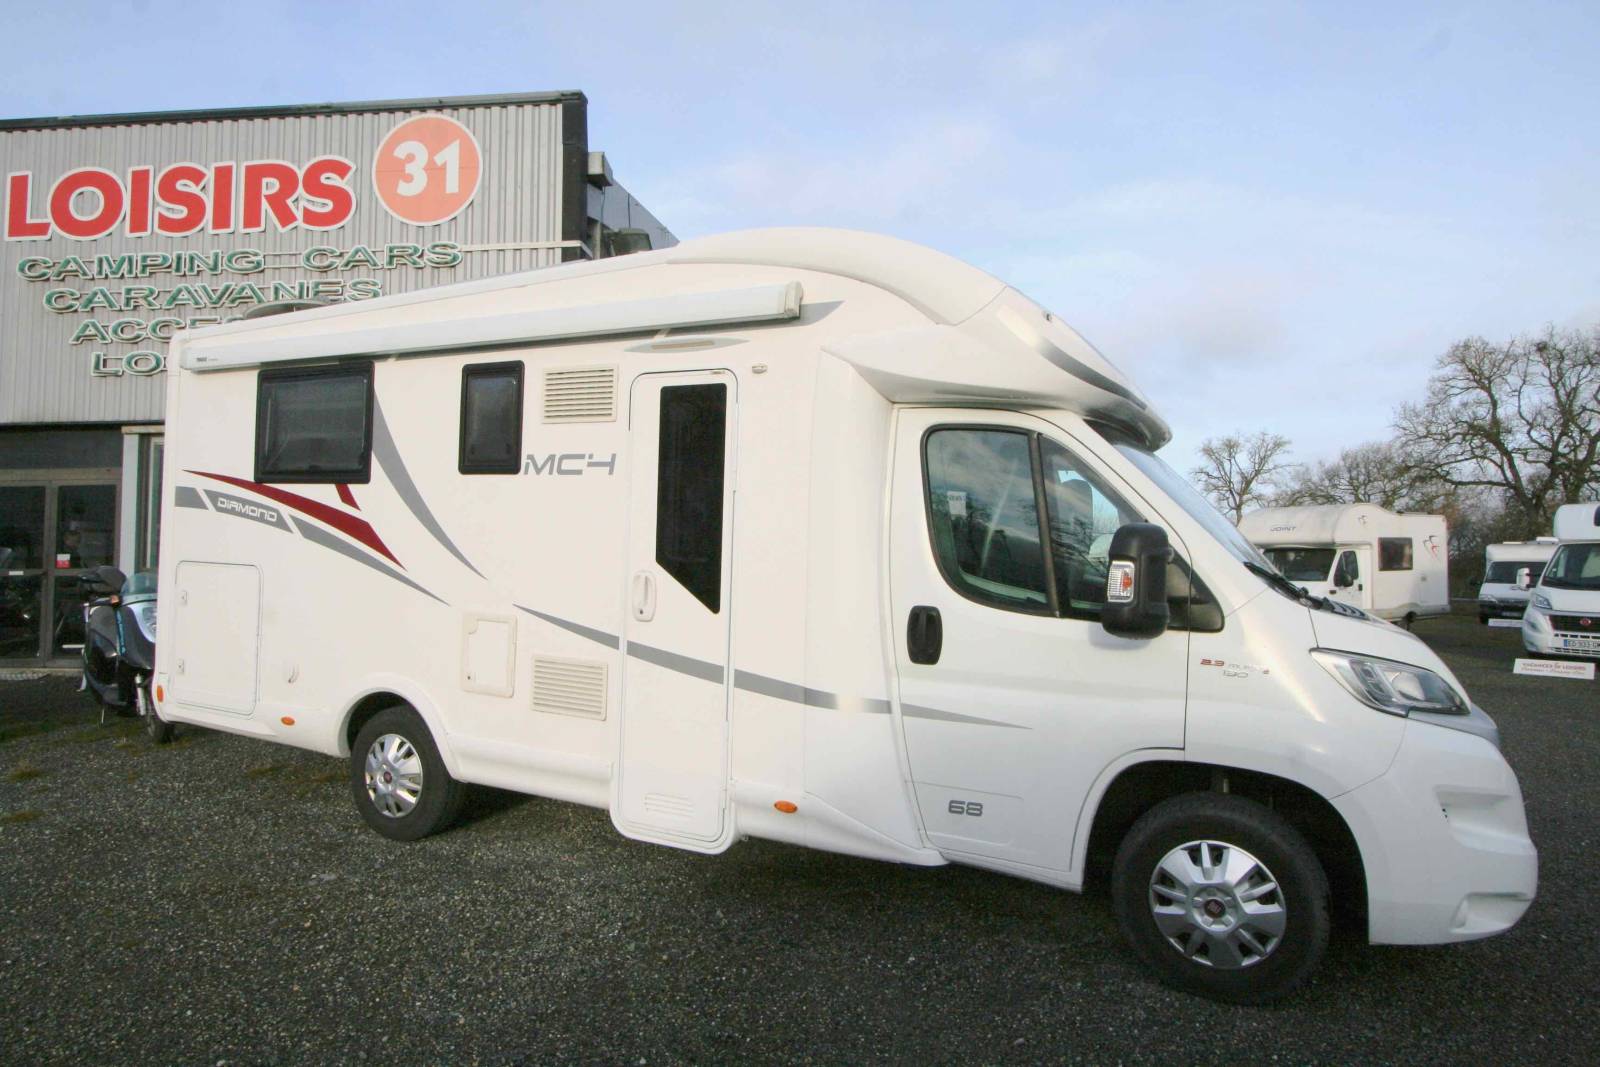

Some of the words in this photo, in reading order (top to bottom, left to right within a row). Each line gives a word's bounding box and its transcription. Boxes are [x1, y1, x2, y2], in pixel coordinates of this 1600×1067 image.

[5, 156, 356, 240] LOISIRS
[392, 138, 461, 197] 31
[16, 249, 265, 281] CAMPING
[302, 241, 463, 271] CARS
[43, 279, 382, 313] CARAVANES
[217, 497, 278, 522] DIAMOND
[948, 799, 984, 817] 68
